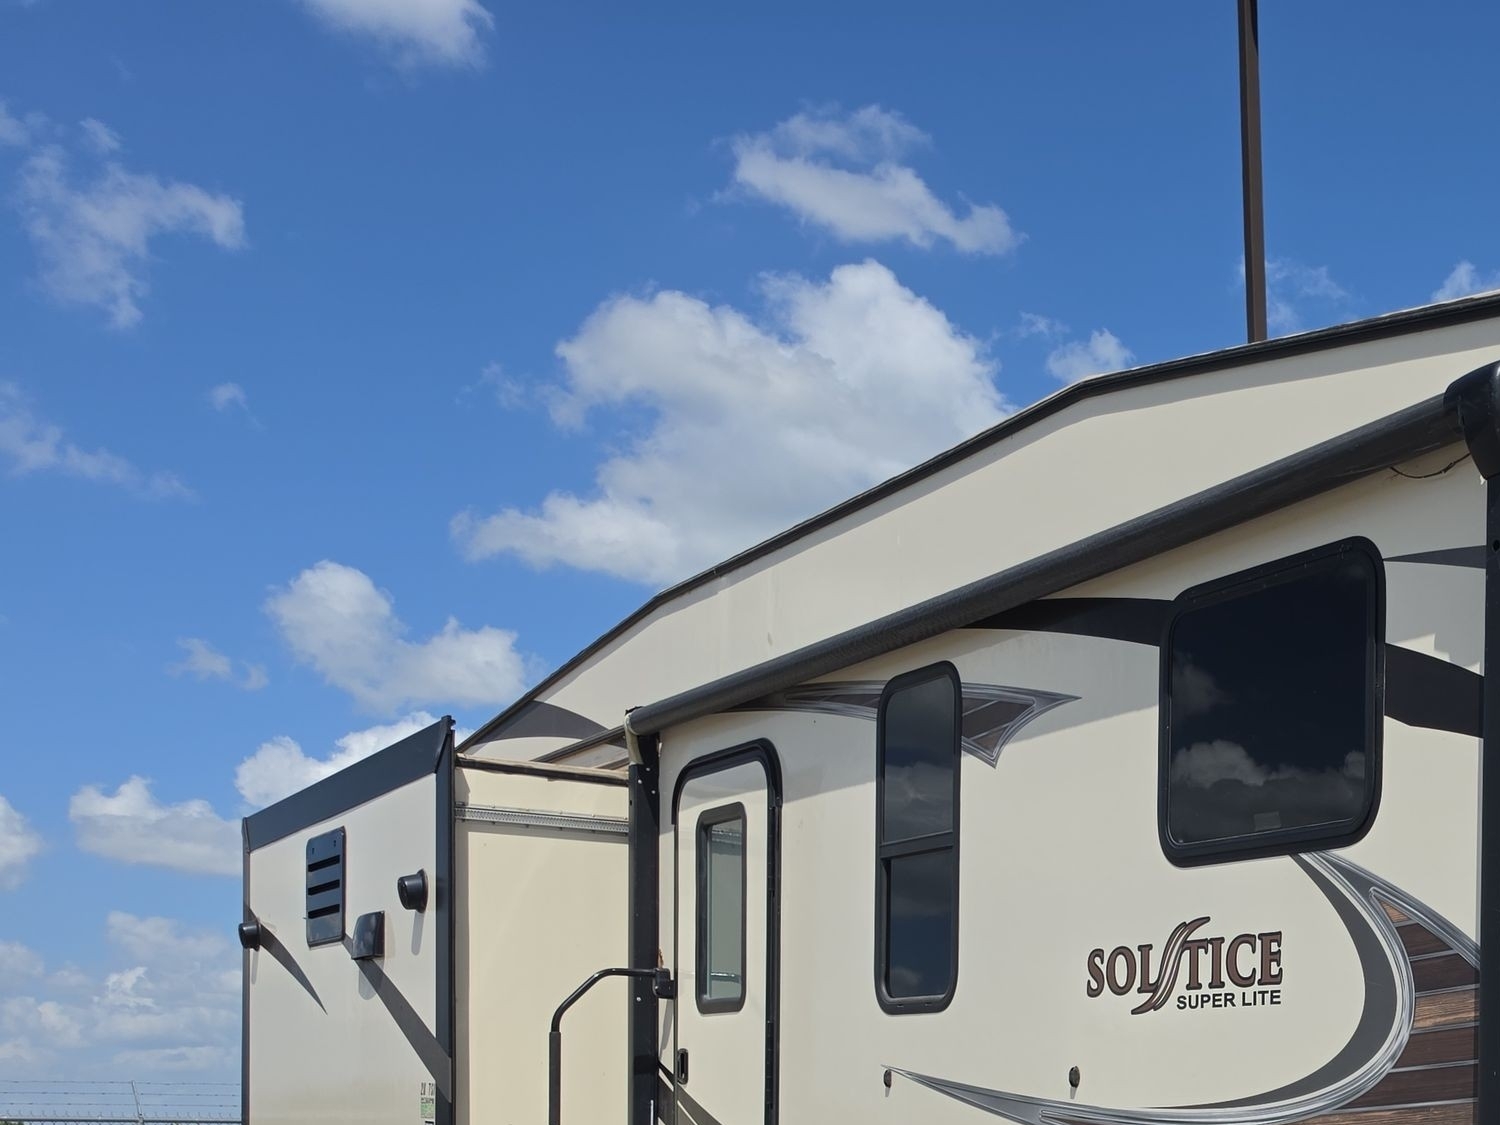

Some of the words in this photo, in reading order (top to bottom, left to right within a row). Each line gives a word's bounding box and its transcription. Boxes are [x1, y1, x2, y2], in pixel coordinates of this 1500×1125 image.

[1087, 916, 1283, 1015] SOLSTICE
[1176, 991, 1236, 1010] SUPER
[1241, 990, 1281, 1007] LITE
